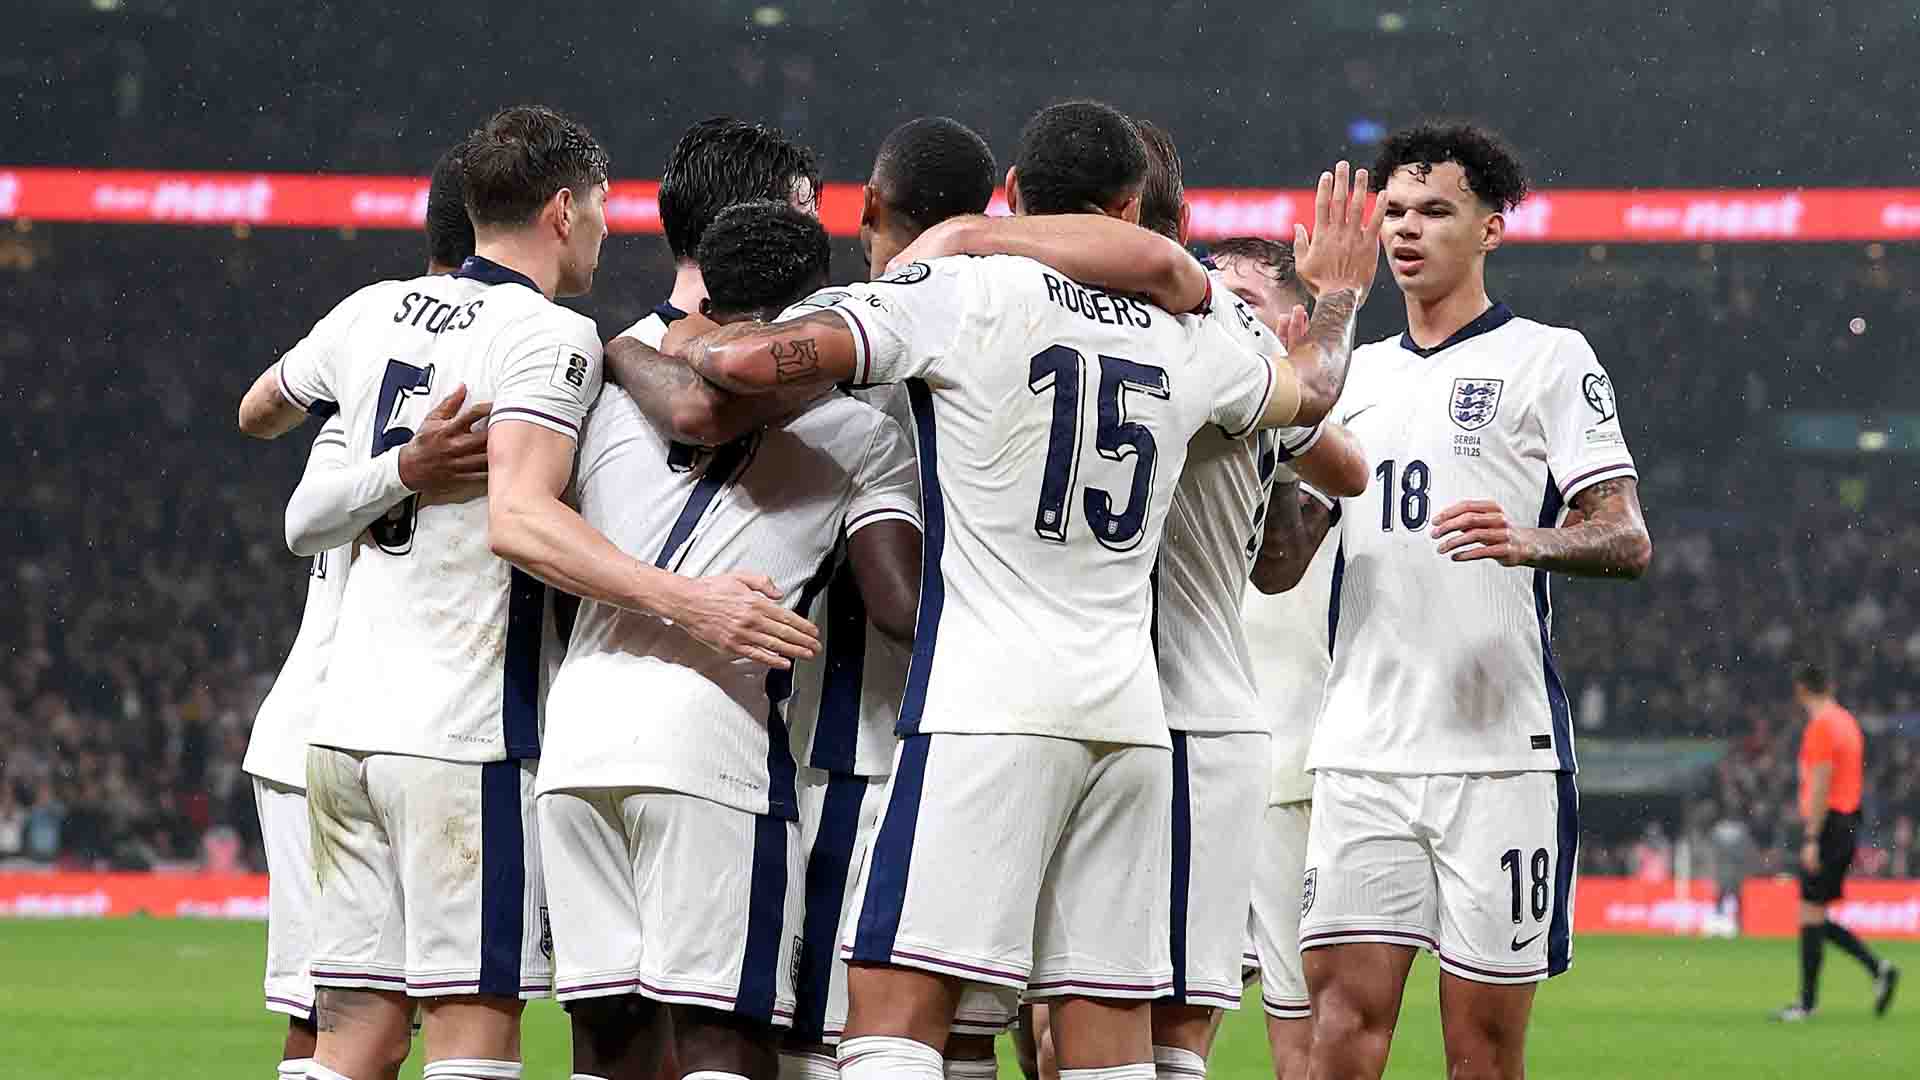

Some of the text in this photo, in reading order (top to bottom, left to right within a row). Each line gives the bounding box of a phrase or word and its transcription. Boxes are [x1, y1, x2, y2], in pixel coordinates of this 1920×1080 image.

[393, 291, 484, 334] STOES
[1043, 272, 1151, 329] ROGERS
[1029, 343, 1170, 552] 15
[1453, 434, 1481, 445] SERBIA
[1376, 459, 1431, 532] 18
[1500, 847, 1550, 924] 18
